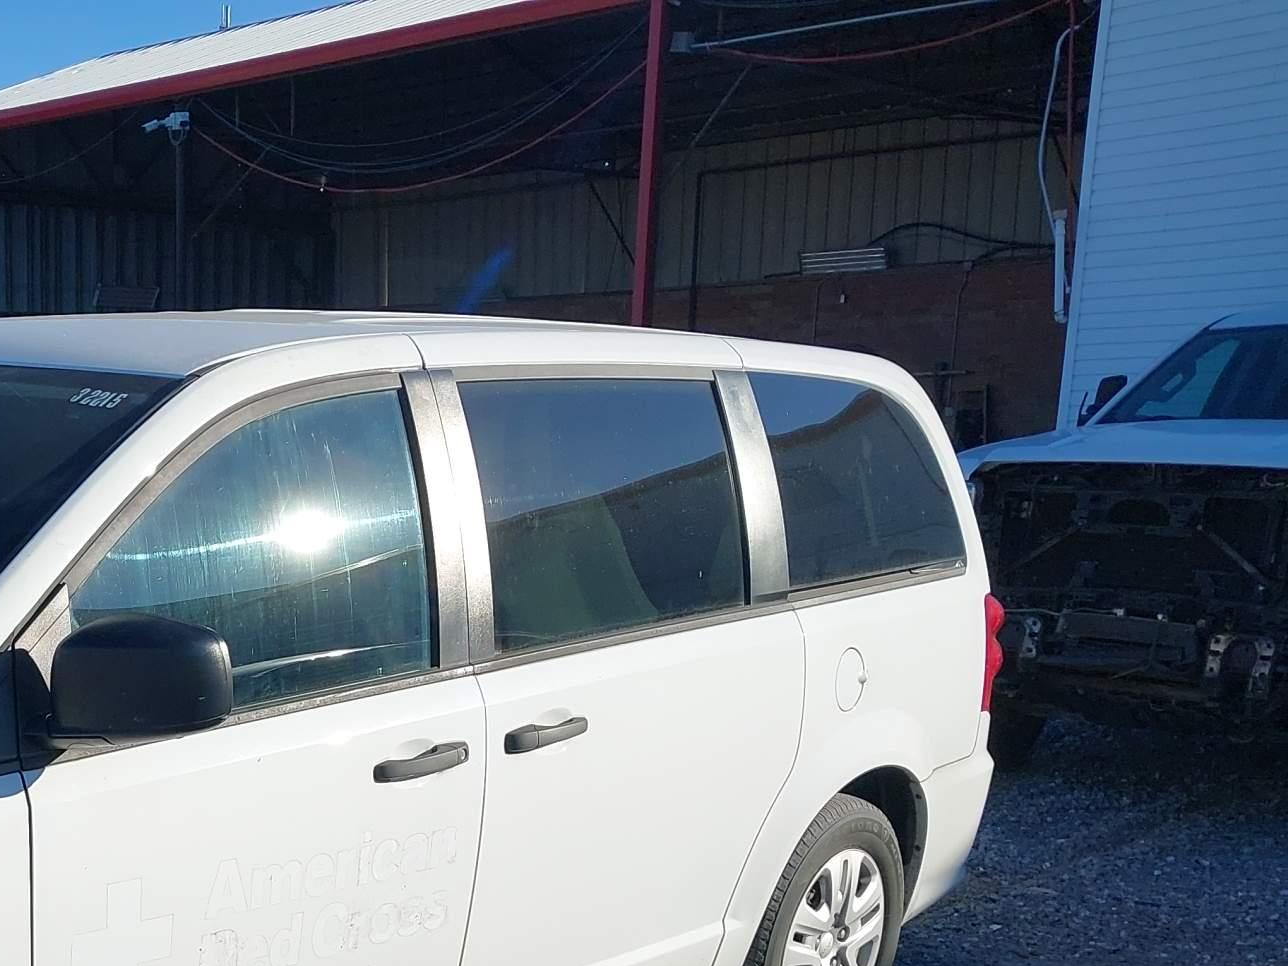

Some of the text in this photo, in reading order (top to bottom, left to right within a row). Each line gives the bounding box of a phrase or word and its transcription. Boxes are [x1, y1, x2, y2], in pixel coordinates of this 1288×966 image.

[69, 387, 129, 409] 32215
[202, 825, 457, 920] American
[312, 889, 449, 959] Cross
